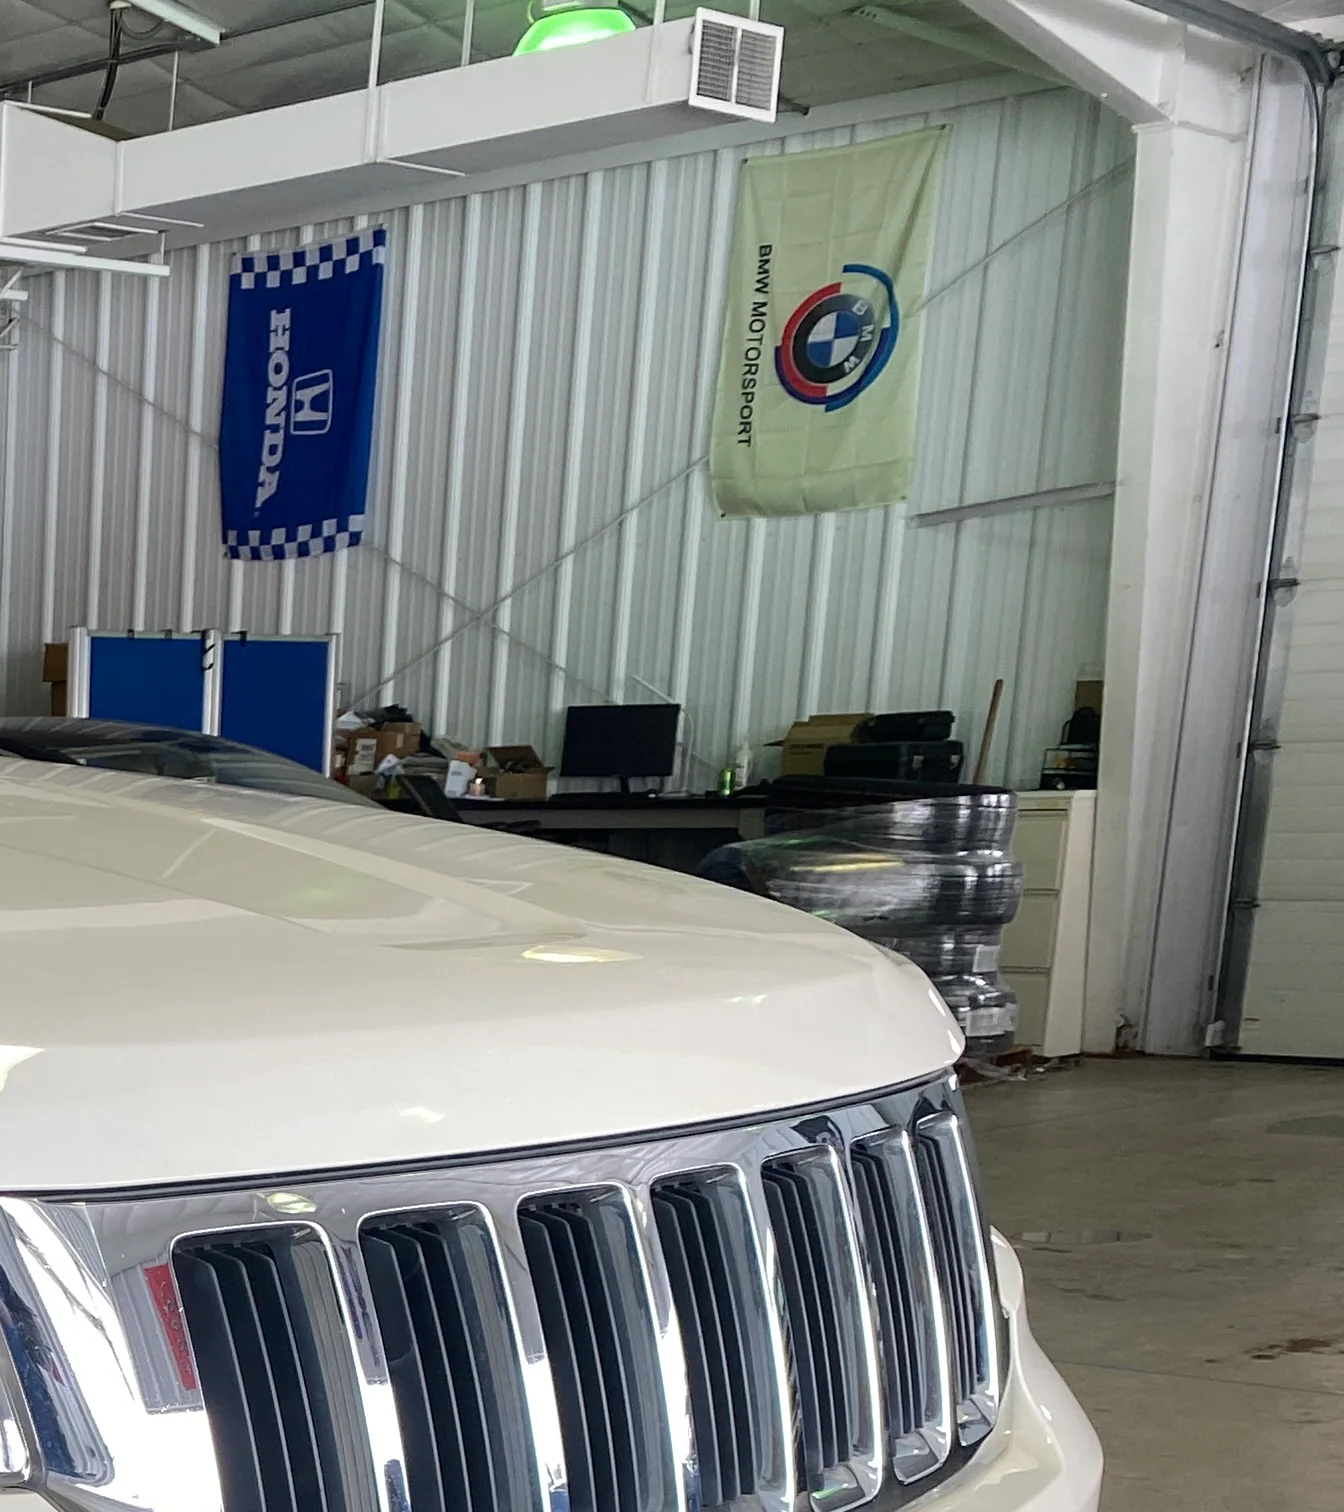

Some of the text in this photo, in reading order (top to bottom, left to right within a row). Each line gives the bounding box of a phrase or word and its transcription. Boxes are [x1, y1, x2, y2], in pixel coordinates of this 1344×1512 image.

[254, 308, 292, 508] HONDA
[737, 244, 773, 447] BMW MOTORSPORT
